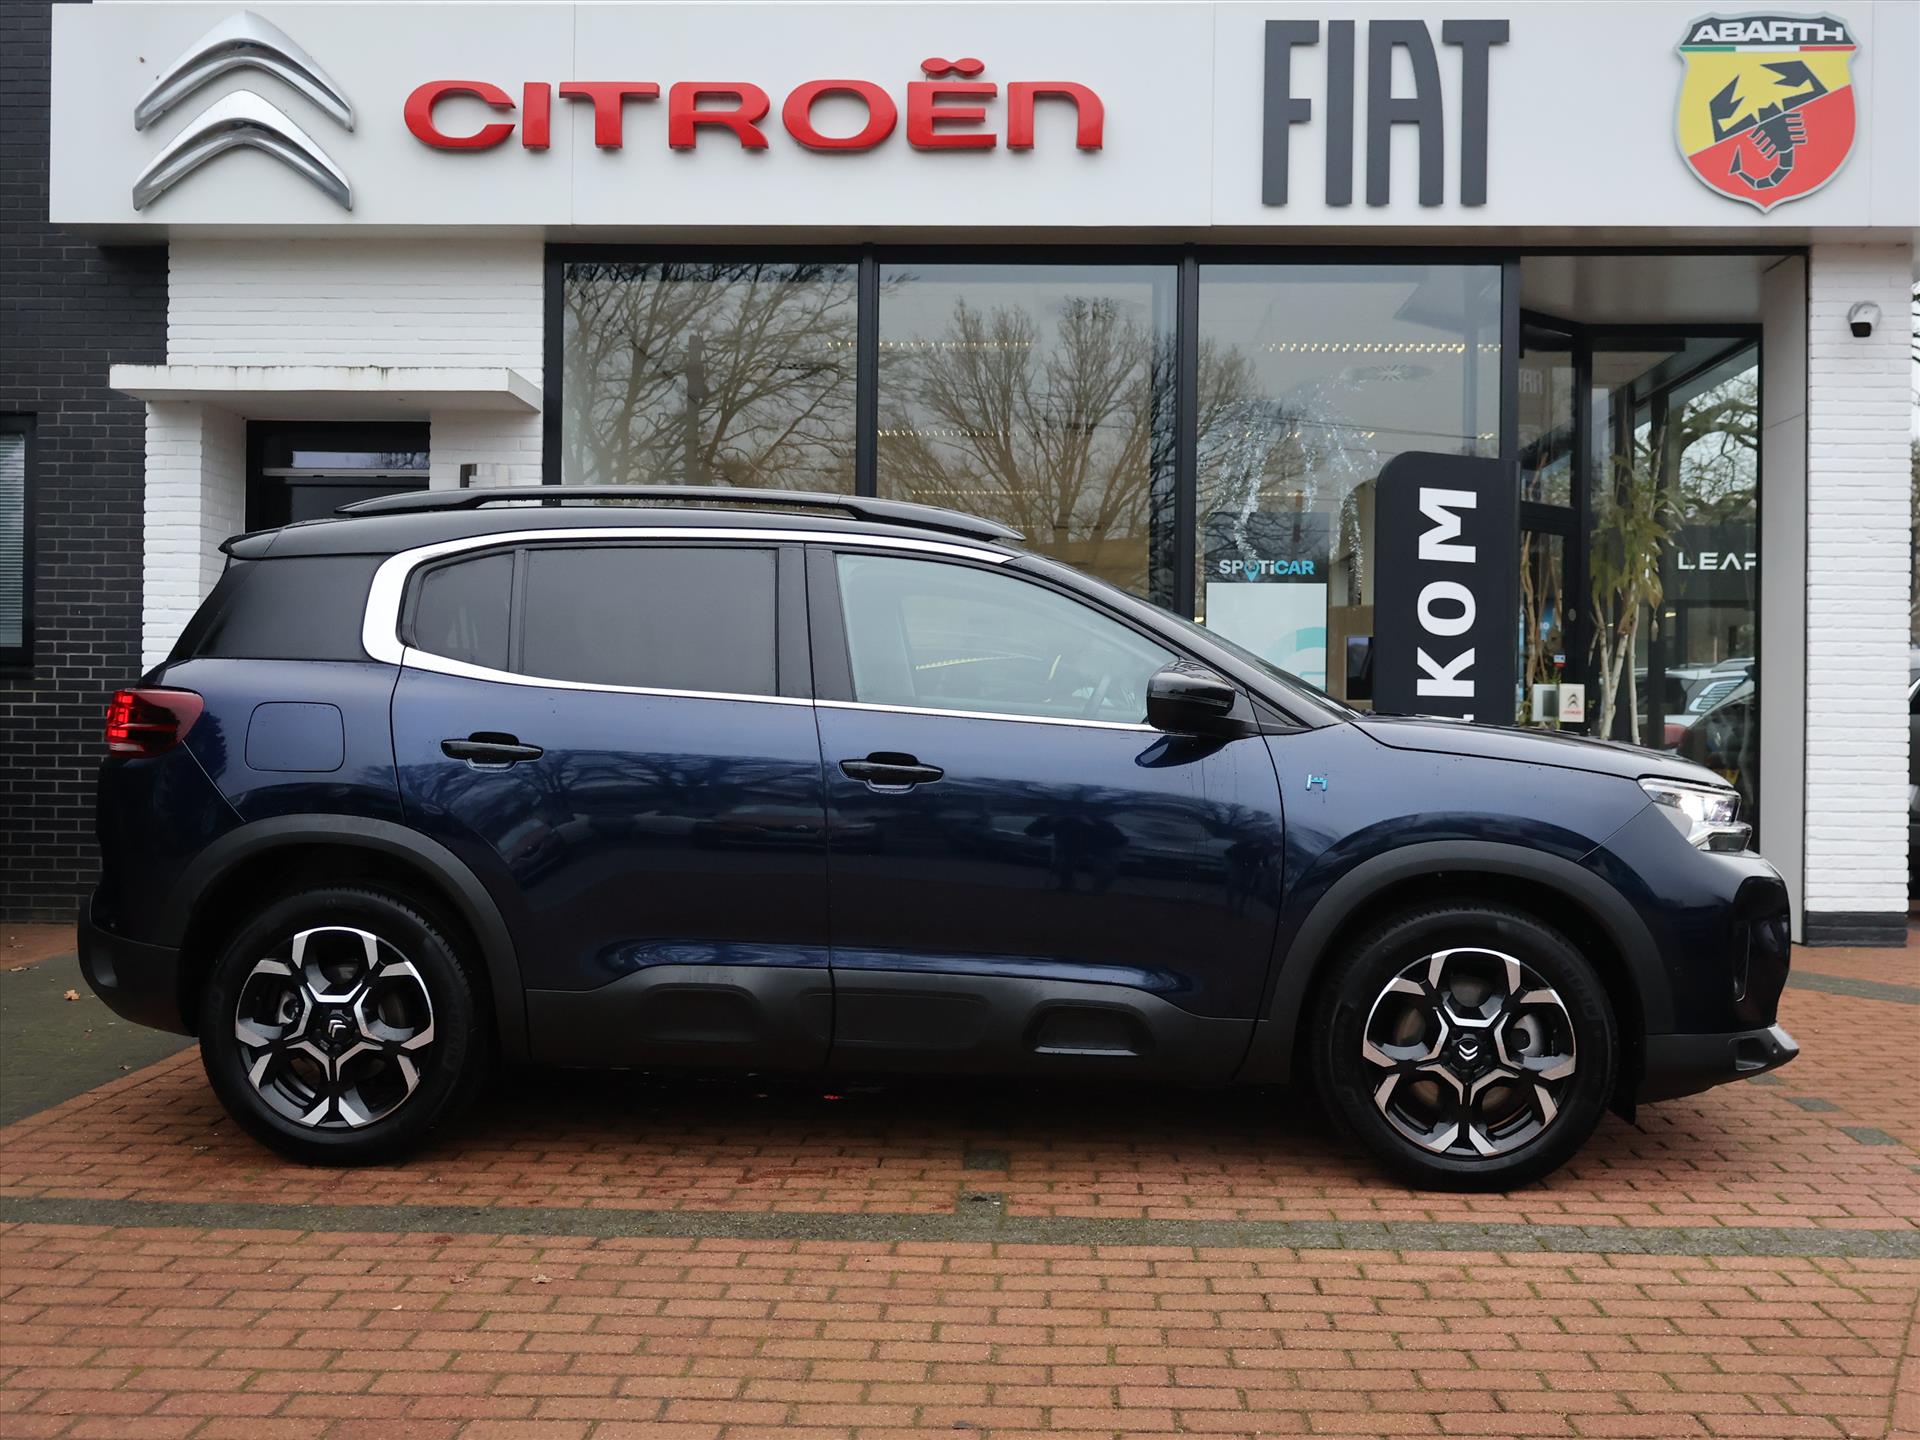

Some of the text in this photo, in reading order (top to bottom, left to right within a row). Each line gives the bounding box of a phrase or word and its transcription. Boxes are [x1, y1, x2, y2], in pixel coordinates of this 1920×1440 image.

[1692, 20, 1844, 43] ABARTH
[404, 57, 1104, 152] CITROËN
[1262, 19, 1509, 207] FIAT
[1416, 486, 1477, 721] KOM
